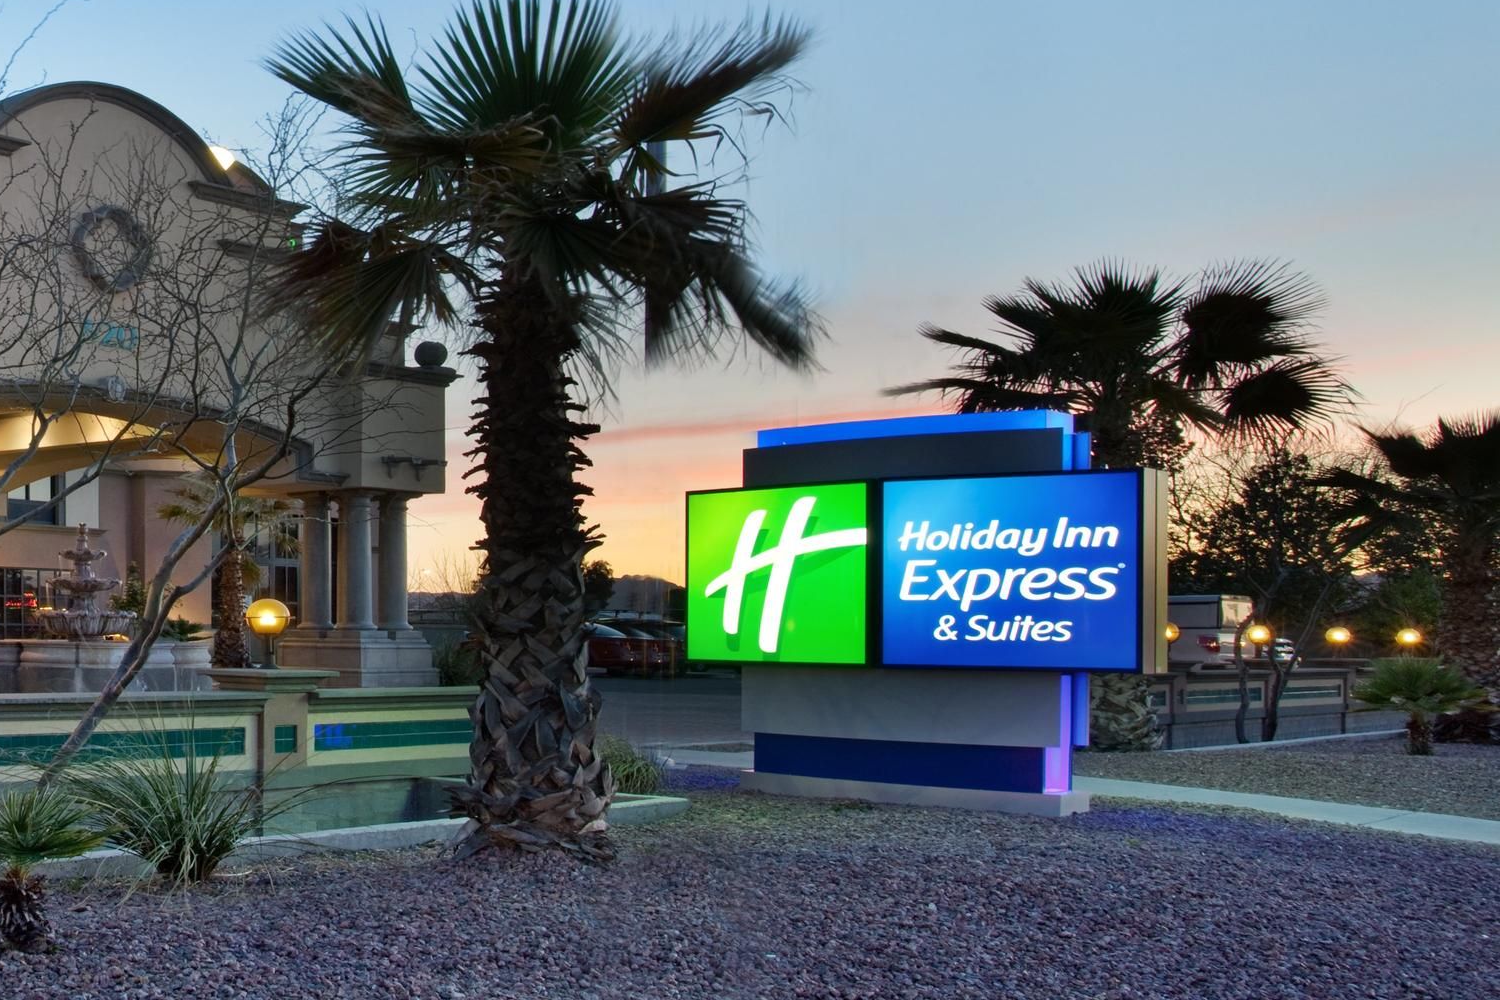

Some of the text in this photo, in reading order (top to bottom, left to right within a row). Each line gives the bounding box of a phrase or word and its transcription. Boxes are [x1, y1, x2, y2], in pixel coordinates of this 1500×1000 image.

[898, 516, 1119, 557] Holiday Inn
[899, 559, 1120, 612] Express
[933, 614, 1073, 642] & Suites
